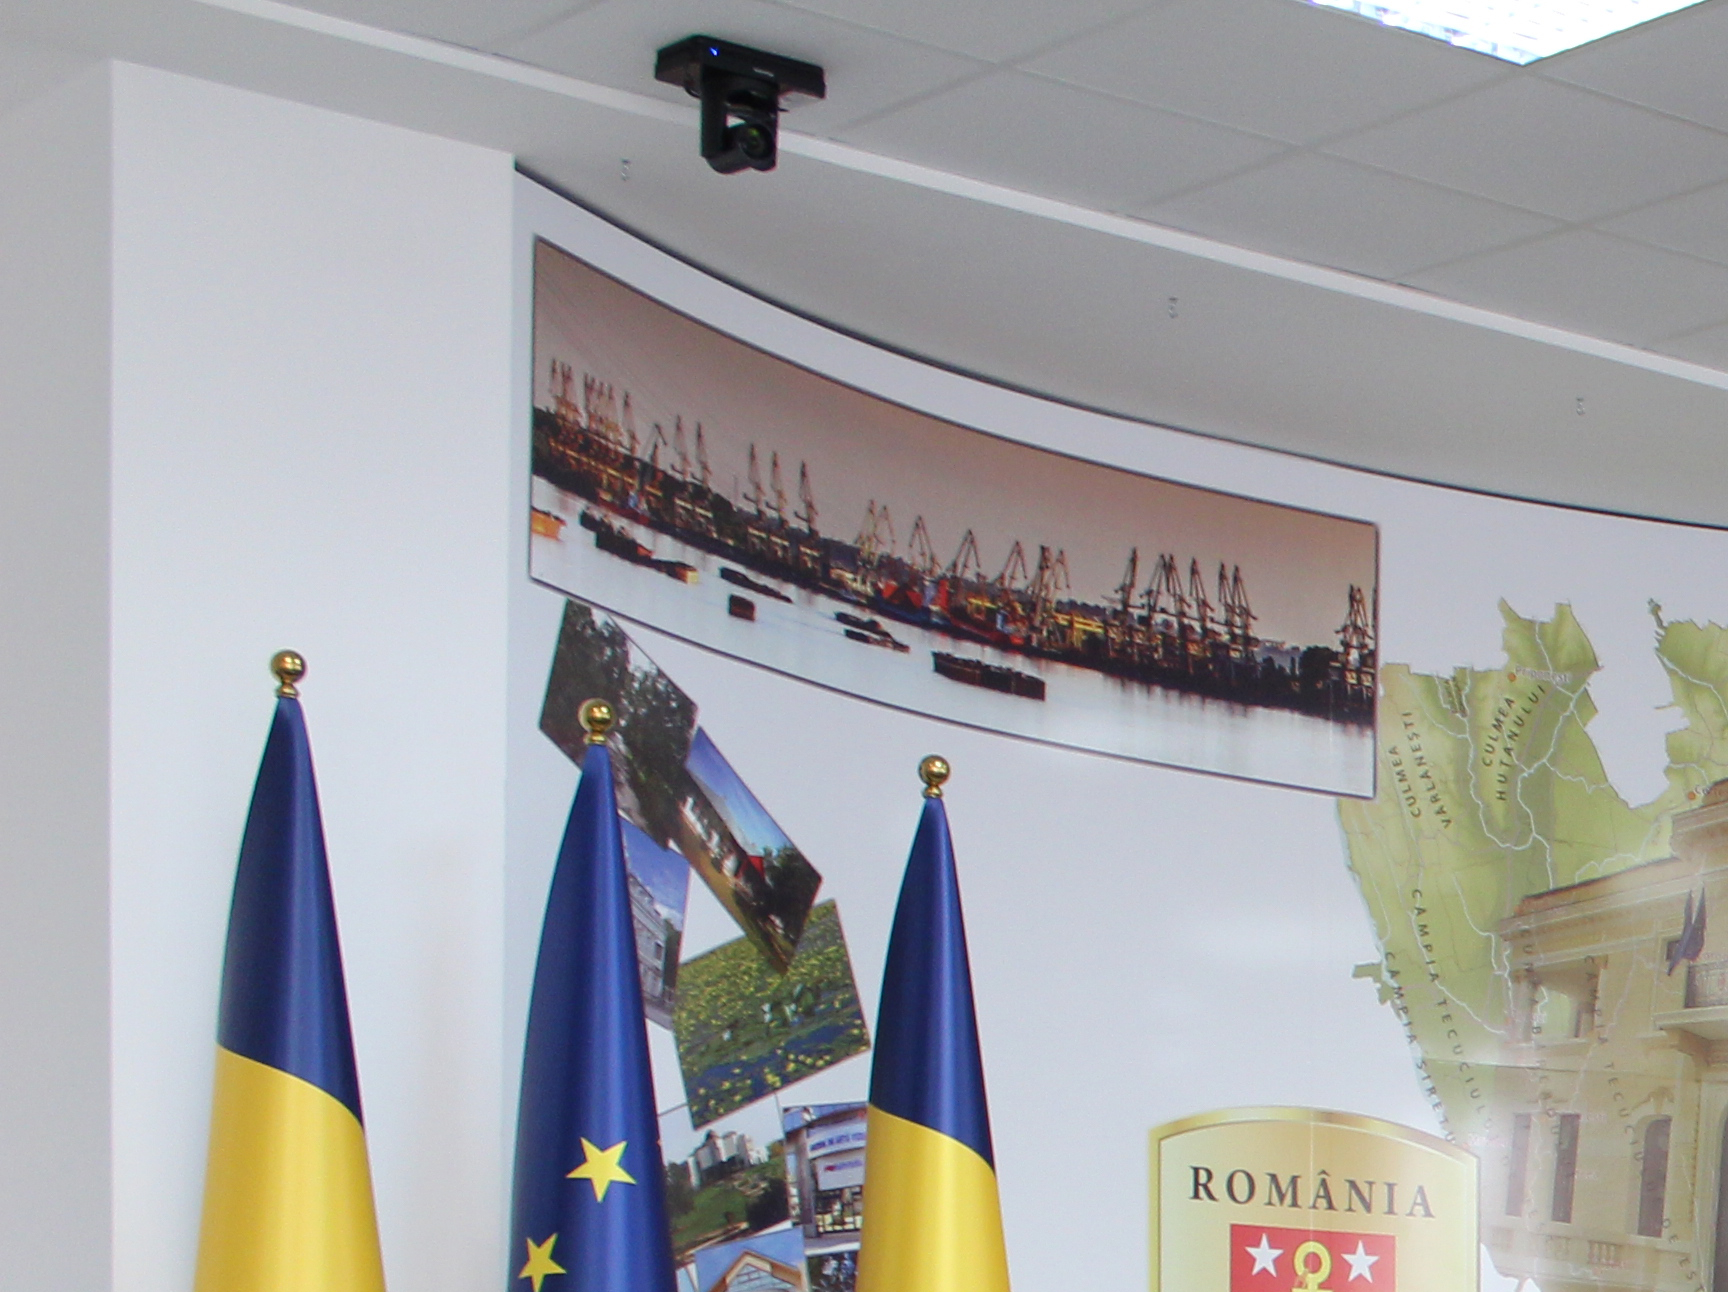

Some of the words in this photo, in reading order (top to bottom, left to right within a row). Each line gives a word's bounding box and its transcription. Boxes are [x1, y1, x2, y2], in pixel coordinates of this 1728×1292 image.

[1482, 697, 1515, 767] CULMEA
[1388, 746, 1421, 818] CULMEA
[1412, 889, 1439, 983] CAMPIA
[1384, 952, 1417, 1044] CAMPIA
[1188, 1166, 1435, 1218] ROMÂNIA
